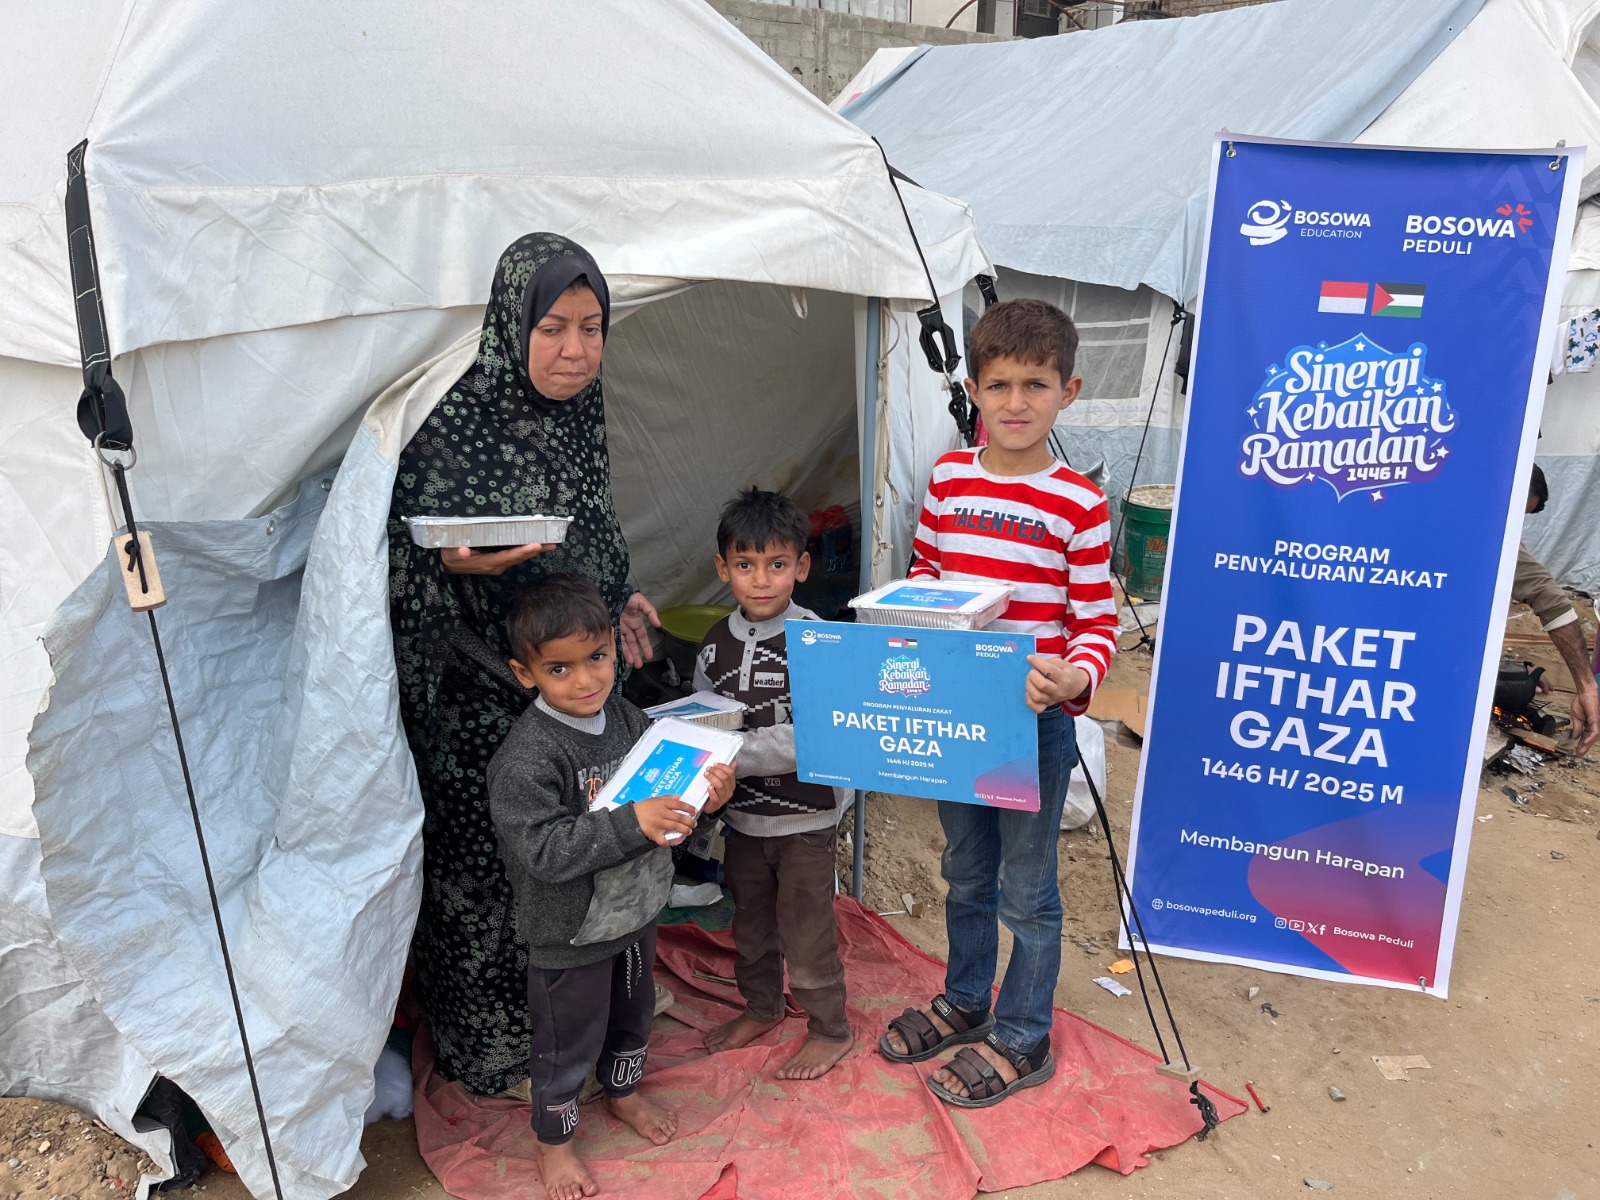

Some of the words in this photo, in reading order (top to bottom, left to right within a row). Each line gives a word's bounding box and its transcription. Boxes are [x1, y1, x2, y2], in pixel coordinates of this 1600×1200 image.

[1294, 210, 1371, 228] BOSOWA
[1405, 215, 1516, 238] BOSOWA
[1300, 228, 1363, 239] EDUCATION
[1402, 239, 1473, 255] PEDULI
[1285, 347, 1422, 398] Sinergi
[1258, 388, 1455, 439] Kebaikan
[1240, 428, 1438, 485] Ramadan
[1347, 467, 1391, 481] 1446
[1394, 466, 1408, 480] H
[951, 507, 1047, 542] TALENTED
[1274, 540, 1390, 565] PROGRAM
[1214, 552, 1365, 584] PENYALURAN
[1369, 567, 1448, 589] ZAKAT
[975, 643, 1013, 653] BOSOWA
[1232, 613, 1417, 670] PAKET
[881, 668, 931, 681] Kebaikan
[886, 658, 919, 671] Sinergi
[754, 677, 784, 687] weather
[879, 679, 929, 693] Ramadan
[1215, 661, 1417, 722] IFTHAR
[863, 701, 892, 709] PROGRAM
[893, 705, 932, 713] PENYALURAN
[832, 710, 903, 733] PAKET
[905, 718, 987, 742] IFTHAR
[879, 735, 943, 758] GAZA
[1229, 710, 1389, 768] GAZA
[663, 757, 685, 781] IFTHAR
[910, 760, 928, 768] 2025
[664, 771, 682, 791] GAZA
[878, 771, 919, 781] Membangun
[919, 775, 947, 785] Harapan
[1201, 757, 1262, 784] 1446
[1304, 772, 1375, 802] 2025
[1380, 784, 1404, 805] M
[1180, 829, 1309, 862] Membangun
[1315, 849, 1405, 879] Harapan
[1166, 900, 1257, 924] bosowapeduli.org
[1333, 926, 1375, 942] Bosowa
[1378, 933, 1414, 949] Peduli
[611, 1051, 646, 1087] 02
